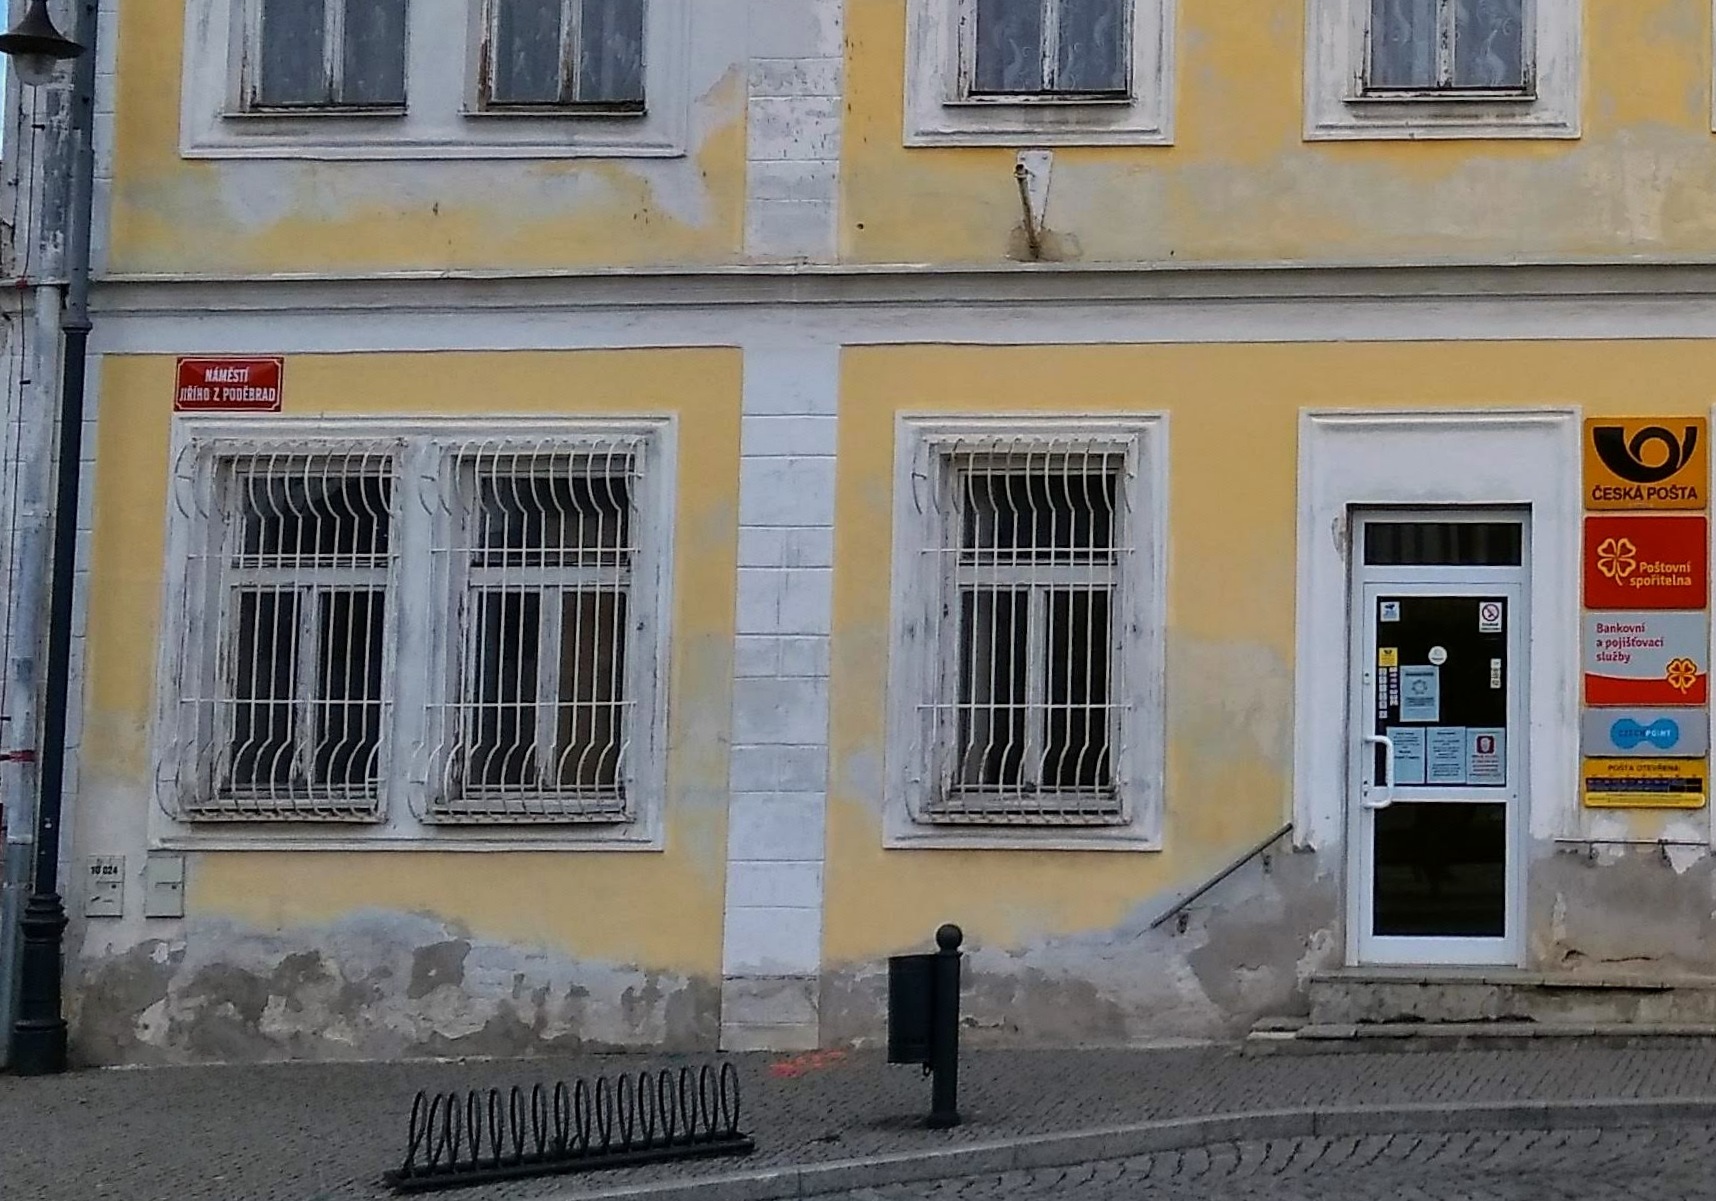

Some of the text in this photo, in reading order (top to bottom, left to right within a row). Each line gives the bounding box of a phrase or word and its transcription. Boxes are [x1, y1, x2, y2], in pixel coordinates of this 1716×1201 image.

[204, 366, 250, 383] NÁMĚSTÍ
[180, 385, 276, 402] JIŘÍHO Z PODĚBRAD
[1592, 484, 1698, 501] ČESKÁ POŠTA
[1639, 561, 1692, 573] Poštovní
[1629, 573, 1692, 589] spořitelna
[1596, 622, 1646, 633] Bankovní
[1596, 636, 1665, 650] a pojišťovací
[1596, 650, 1631, 664] služby
